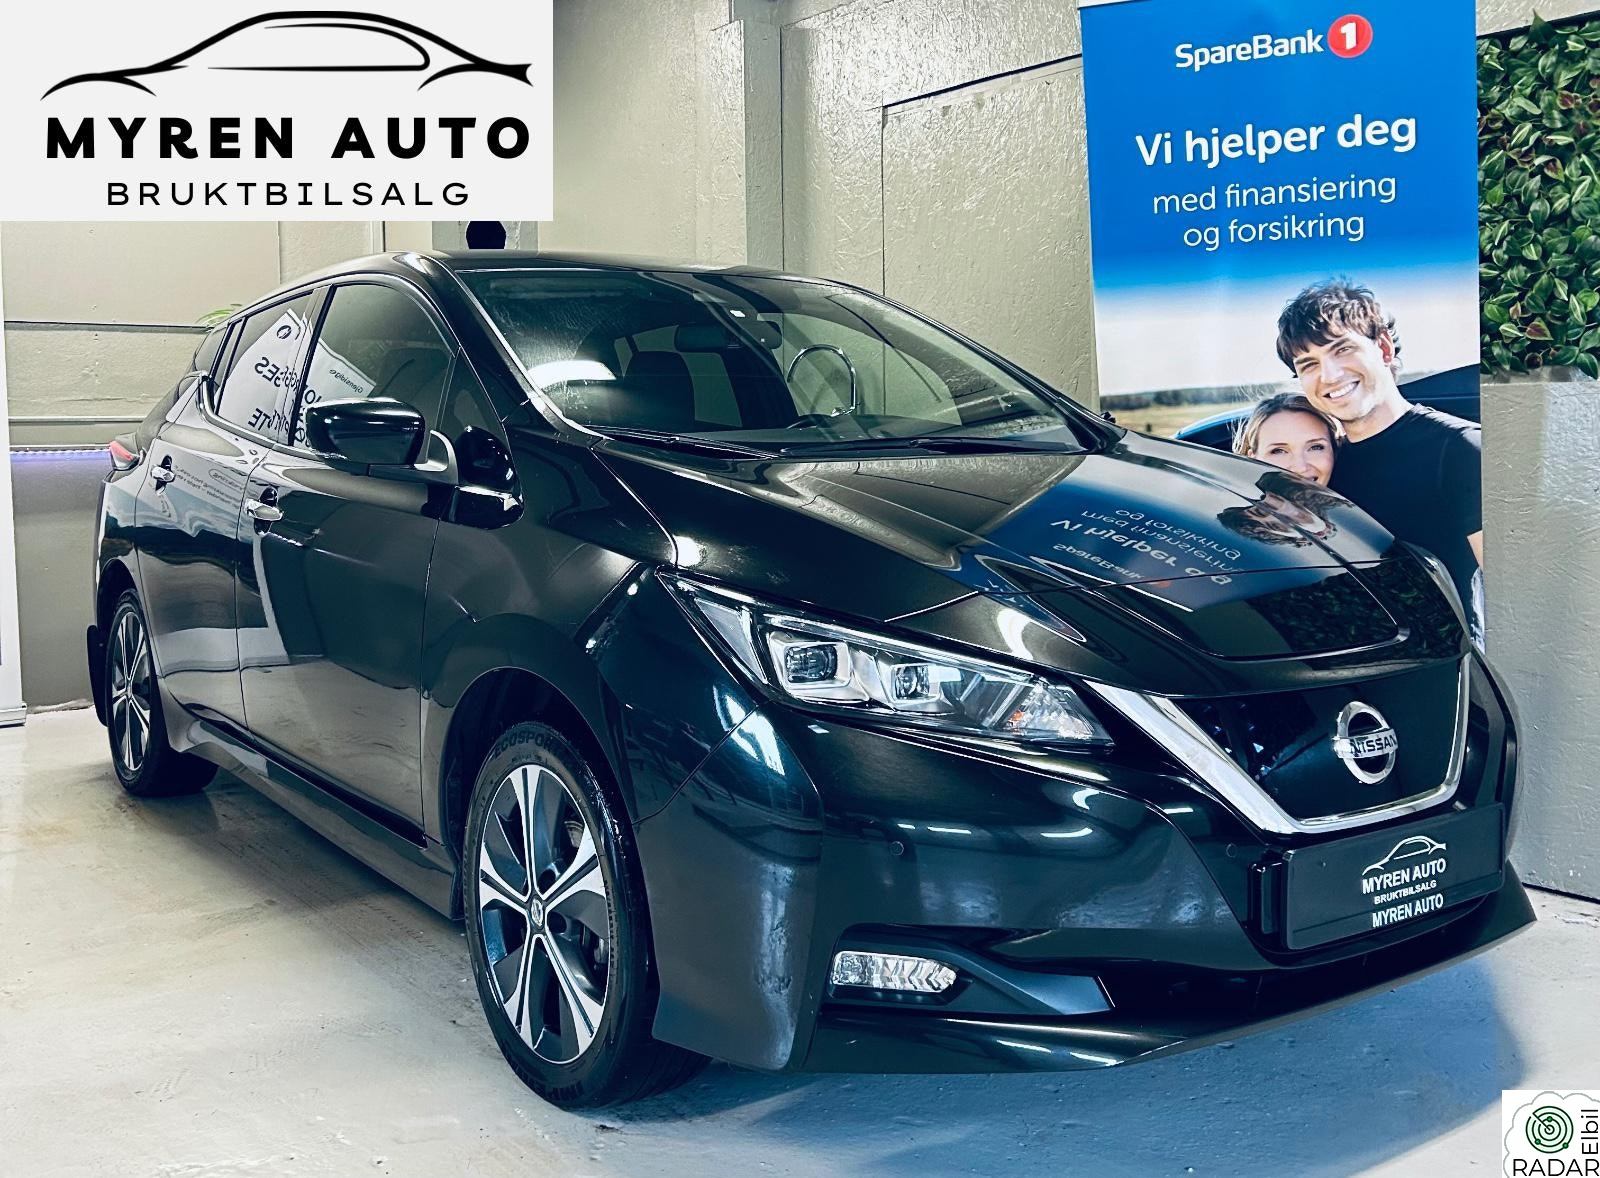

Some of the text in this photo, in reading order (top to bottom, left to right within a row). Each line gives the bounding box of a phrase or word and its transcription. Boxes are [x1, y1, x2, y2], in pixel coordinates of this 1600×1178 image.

[1175, 22, 1357, 72] SpareBank 1
[1135, 113, 1417, 169] Vi hjelper deg
[1153, 173, 1397, 215] med finansiering
[1183, 213, 1365, 252] og forsikring
[1349, 733, 1398, 757] NISSAN
[1361, 857, 1447, 895] MYREN AUTO
[1374, 879, 1438, 905] BRUKTBILSALG
[1371, 893, 1444, 929] MYREN AUTO
